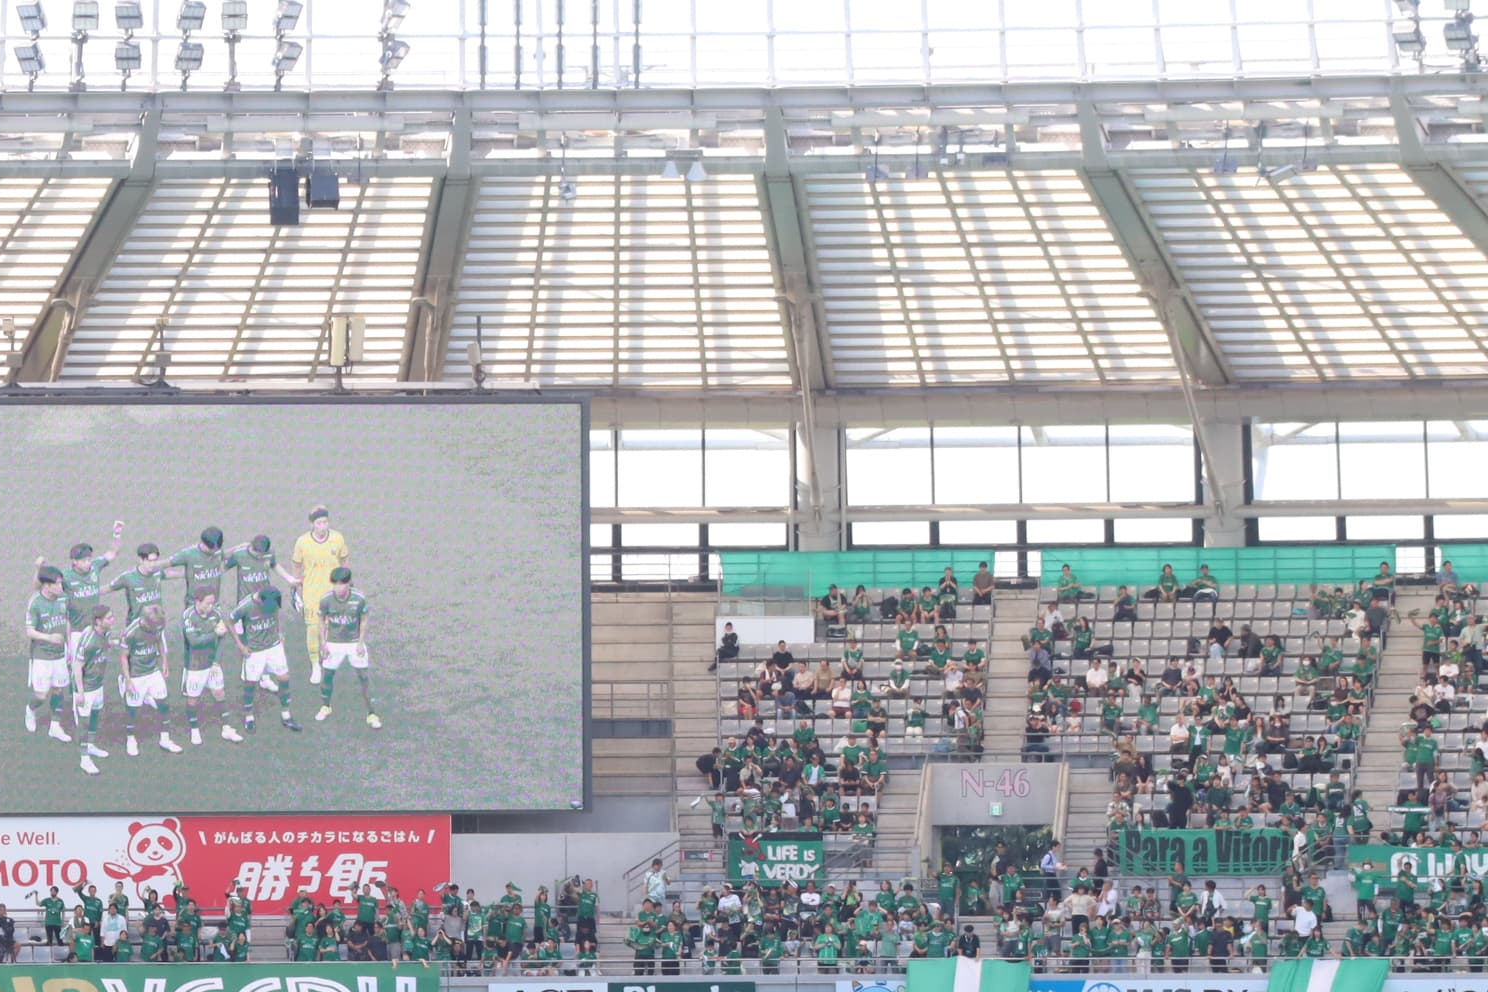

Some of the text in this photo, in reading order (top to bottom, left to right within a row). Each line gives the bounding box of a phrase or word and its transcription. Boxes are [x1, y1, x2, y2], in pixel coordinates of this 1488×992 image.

[961, 768, 1031, 799] N-46
[16, 831, 61, 847] Well.
[214, 830, 420, 845] がんばる人のチカラになるごはん
[766, 845, 799, 862] LIFE
[231, 853, 389, 904] 勝ち飯
[763, 863, 819, 880] VERDY
